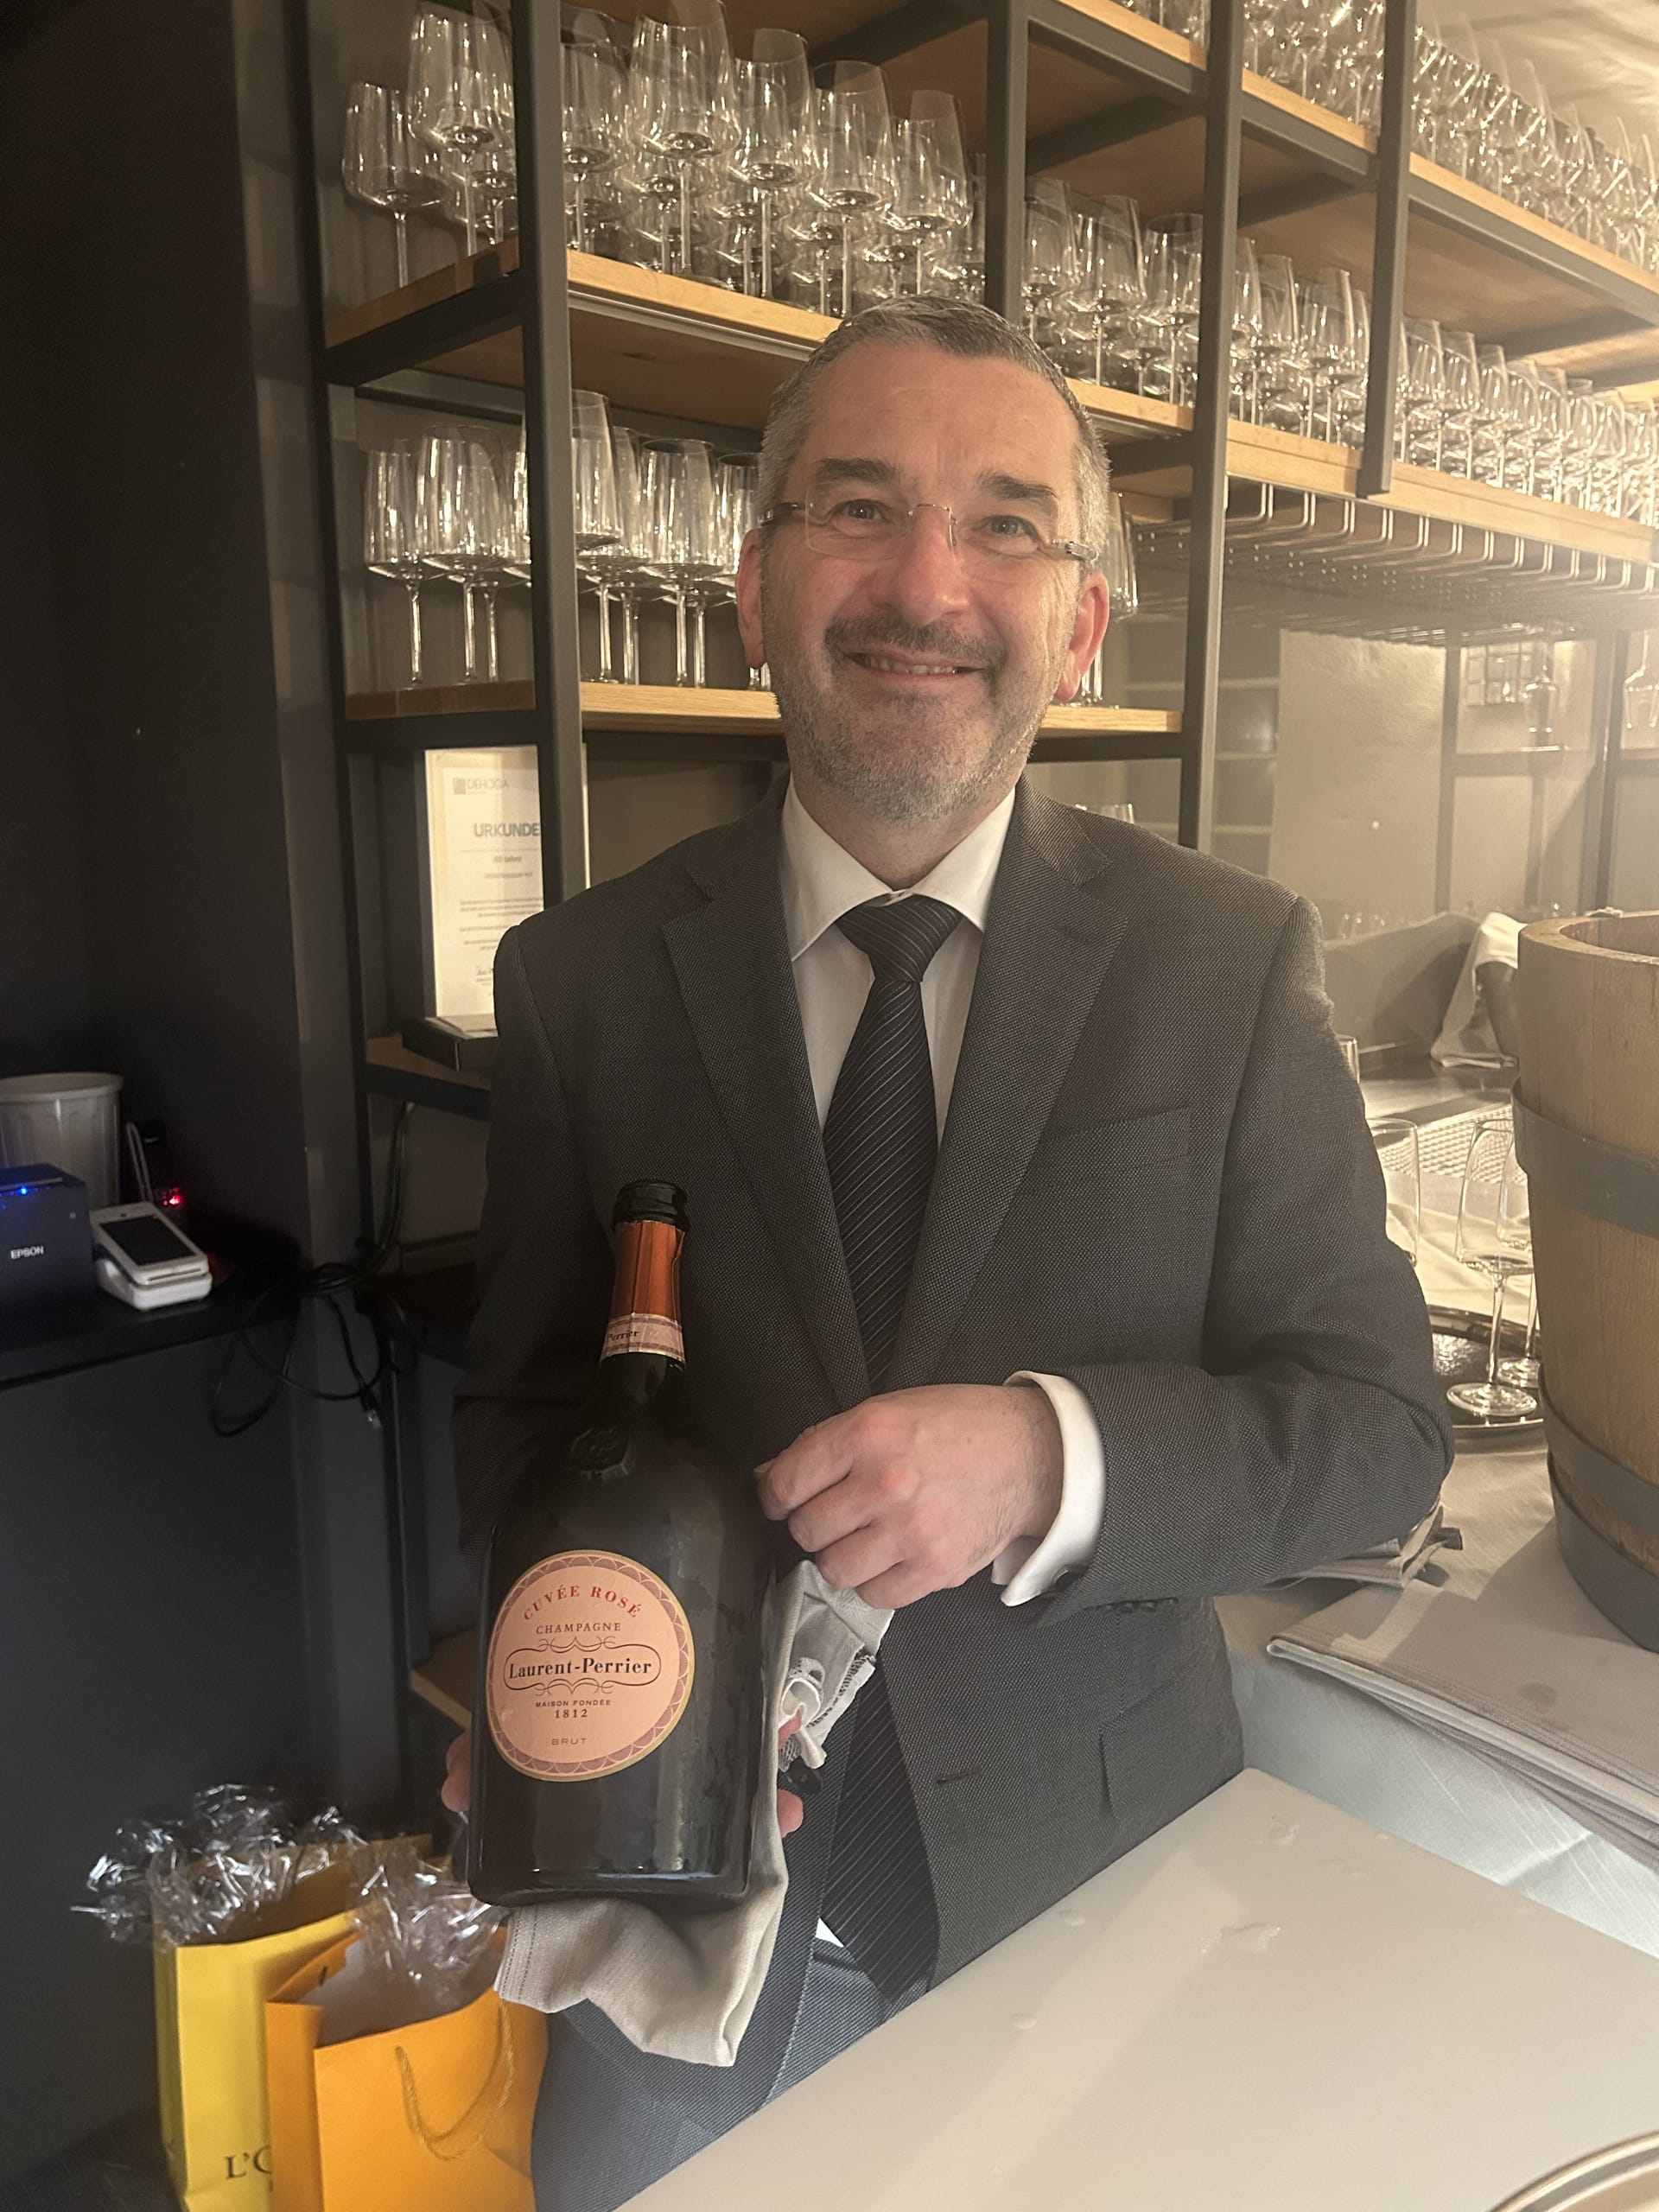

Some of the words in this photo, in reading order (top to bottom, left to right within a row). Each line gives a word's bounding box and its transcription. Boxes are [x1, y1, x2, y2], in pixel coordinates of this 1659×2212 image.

[474, 822, 540, 837] URKUNDE
[10, 1245, 44, 1260] EPSON
[523, 1584, 580, 1620] CUVÉE
[591, 1586, 642, 1618] ROSÉ
[536, 1622, 621, 1635] CHAMPAGNE
[509, 1657, 652, 1679] Laurent-Perrier
[555, 1708, 588, 1719] 1812
